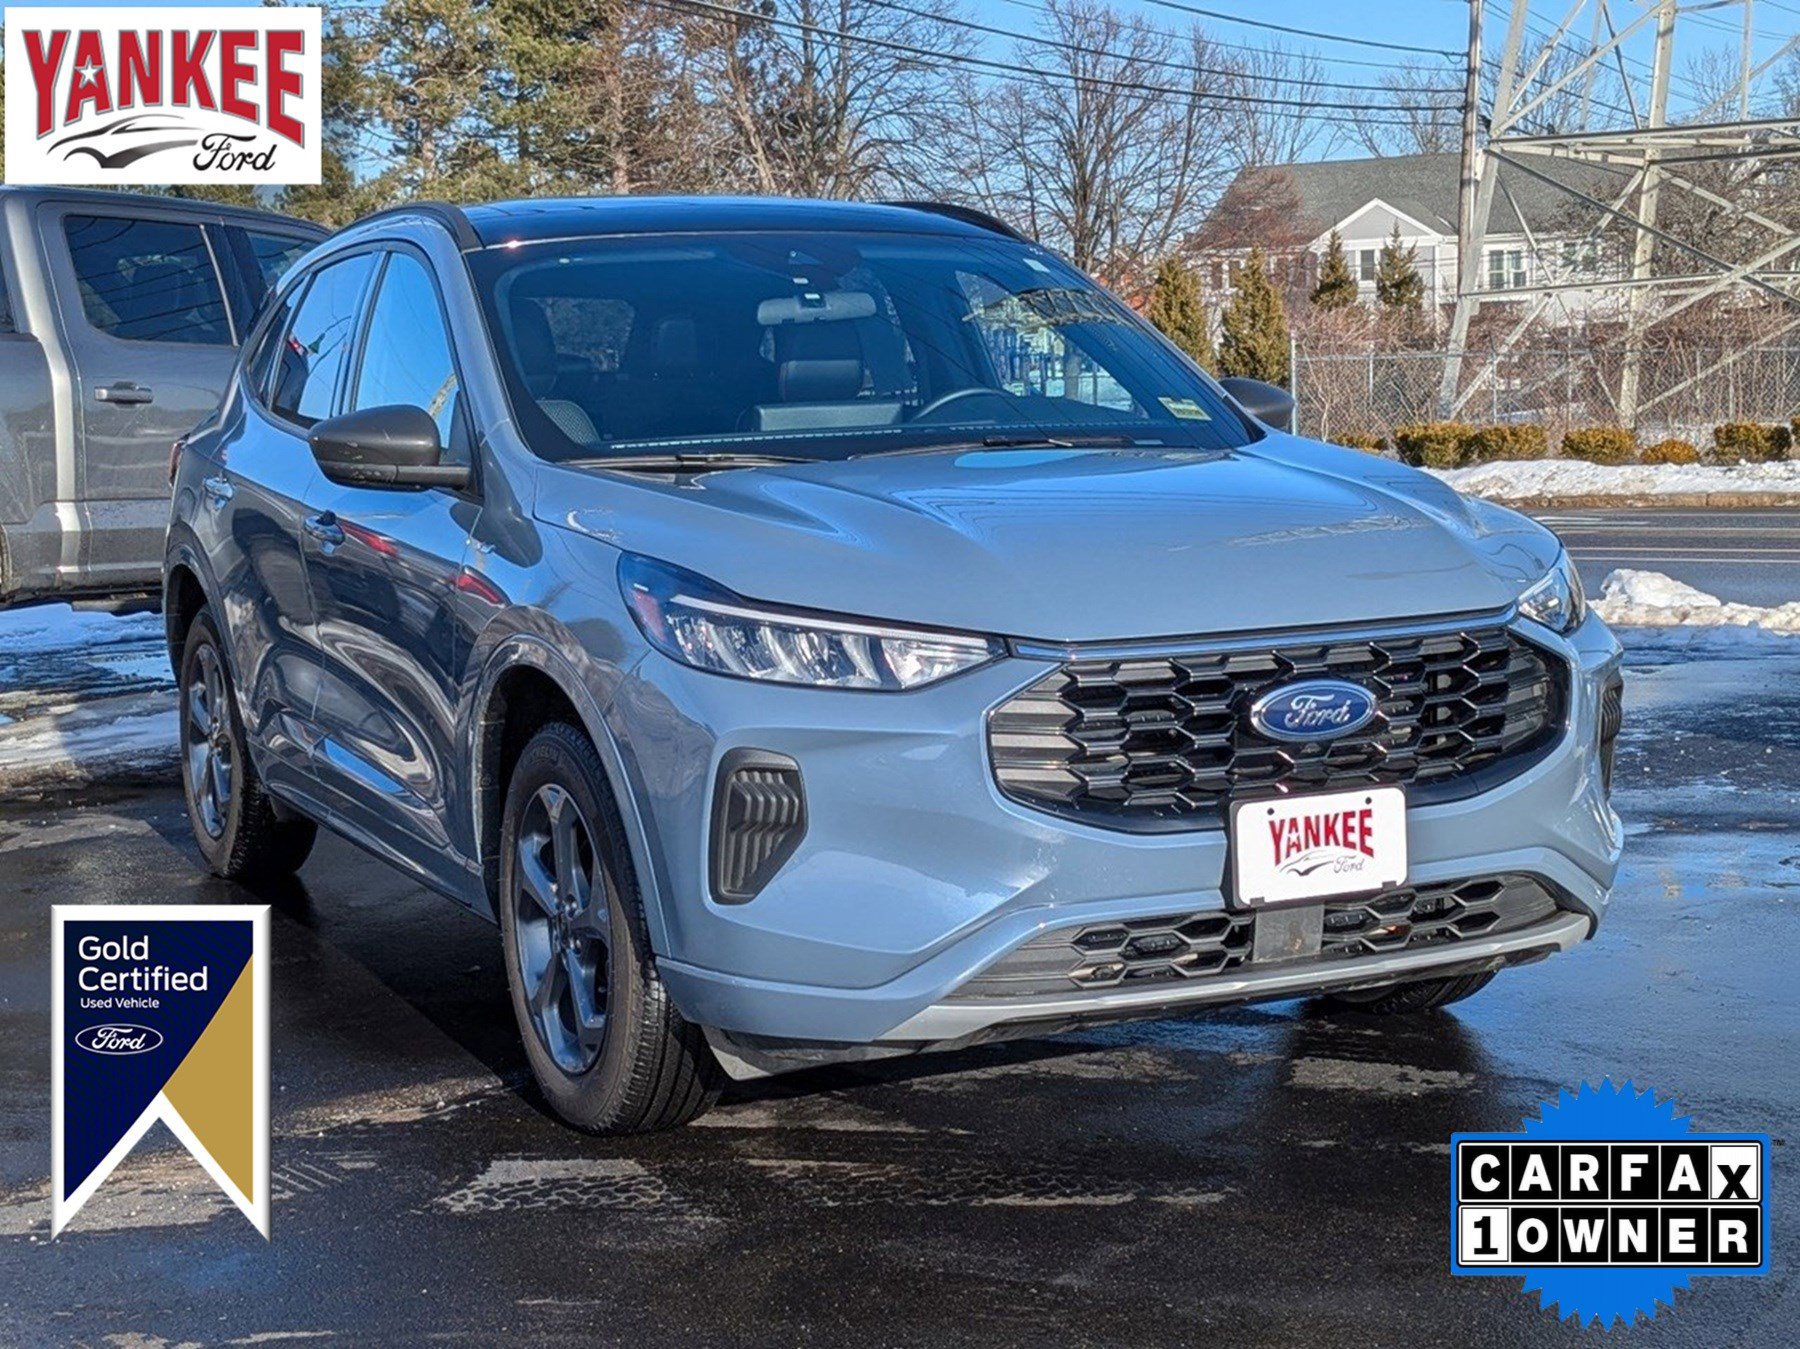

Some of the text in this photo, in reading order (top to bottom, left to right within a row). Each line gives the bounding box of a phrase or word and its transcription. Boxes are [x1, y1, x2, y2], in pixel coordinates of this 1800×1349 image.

[1284, 693, 1351, 729] Ford
[1268, 808, 1375, 866] YANKEE
[1333, 855, 1365, 874] Ford
